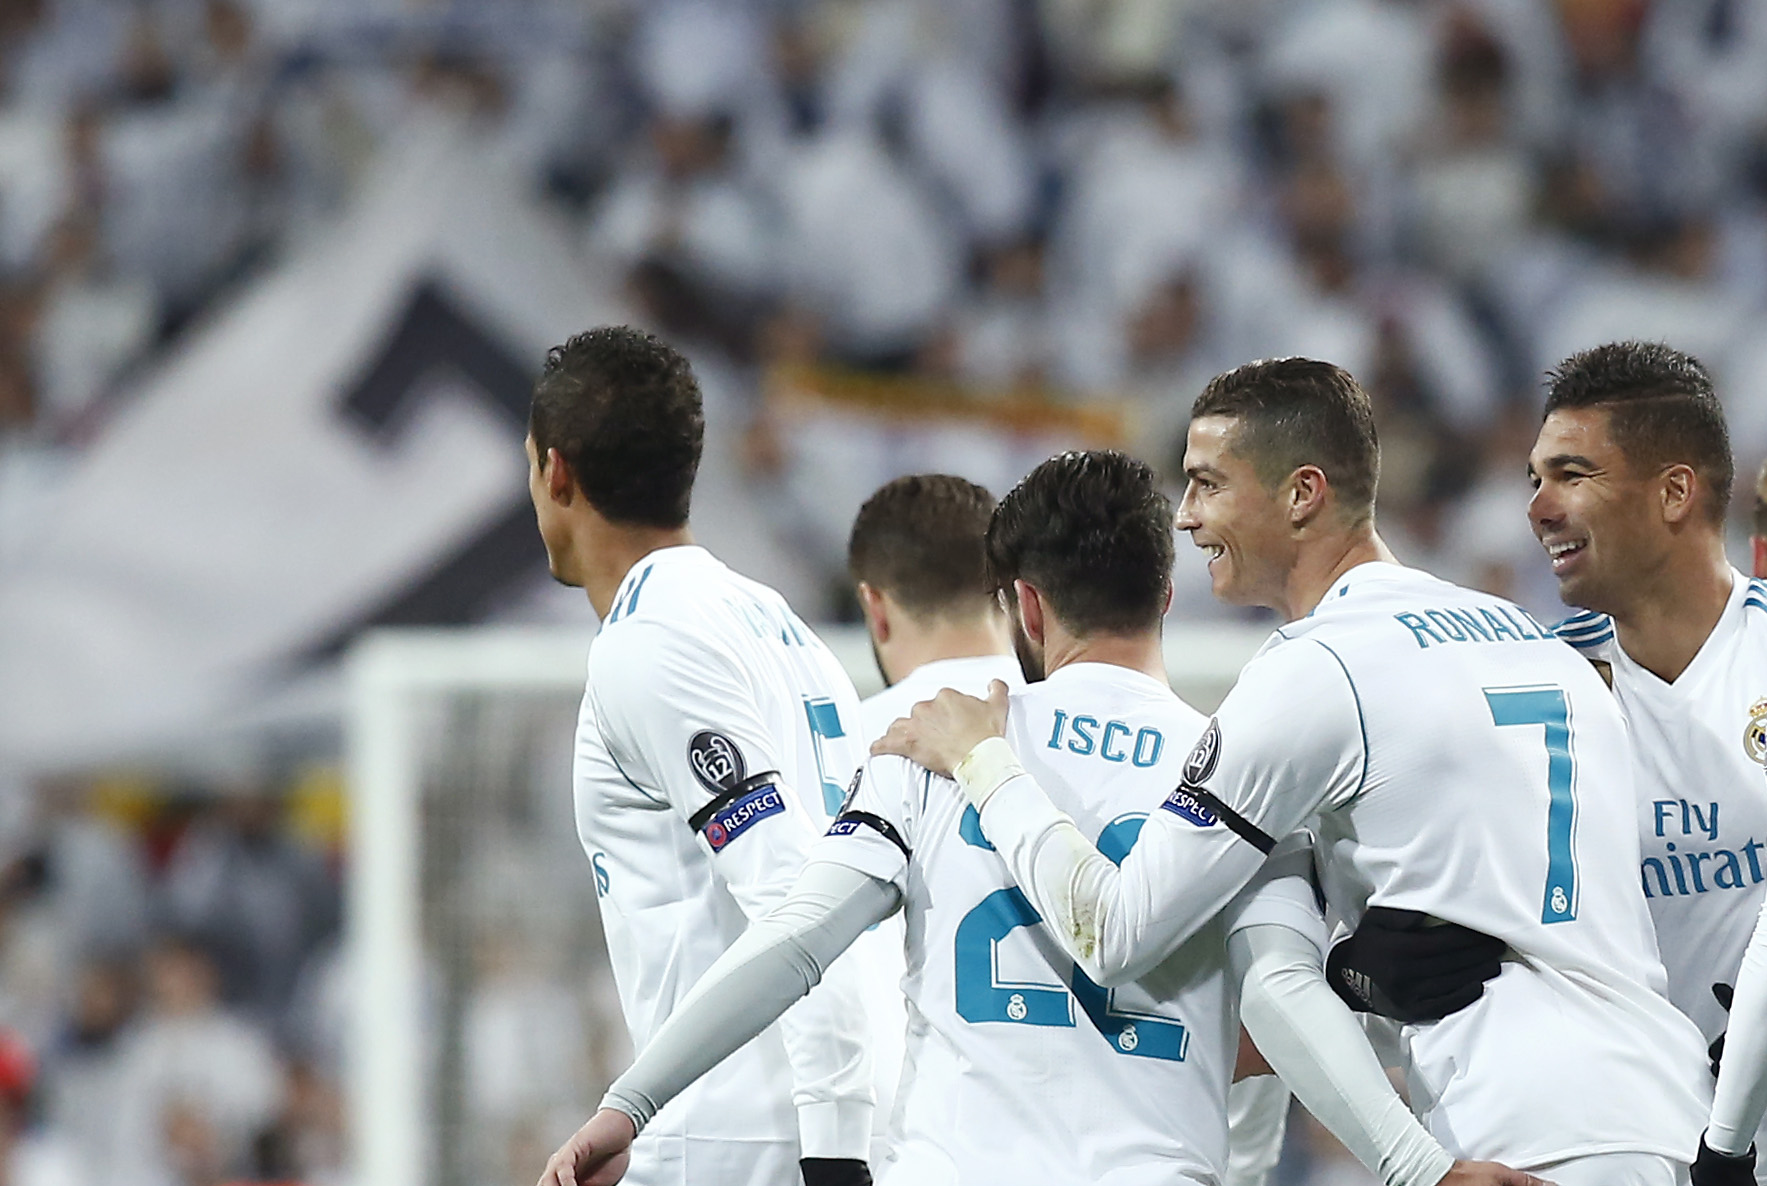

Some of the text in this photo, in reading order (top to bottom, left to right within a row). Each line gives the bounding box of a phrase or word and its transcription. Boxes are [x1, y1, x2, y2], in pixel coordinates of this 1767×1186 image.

[1046, 708, 1165, 769] ISCO
[708, 757, 734, 782] 12
[722, 791, 782, 834] RESPECT
[1482, 683, 1581, 924] 7
[1652, 798, 1719, 841] Fly
